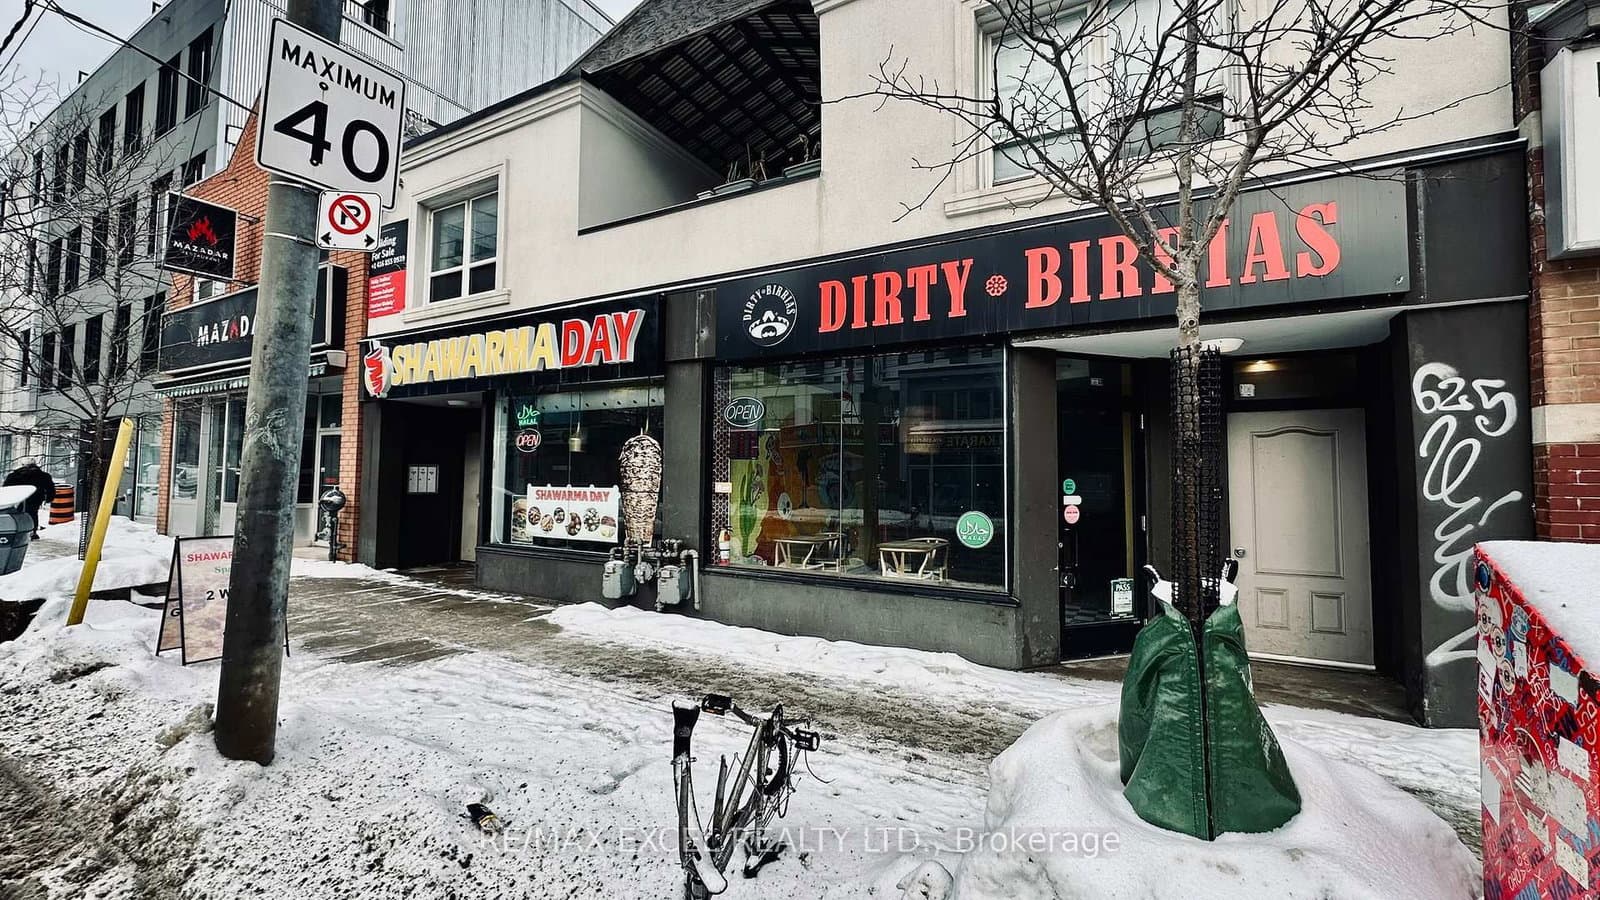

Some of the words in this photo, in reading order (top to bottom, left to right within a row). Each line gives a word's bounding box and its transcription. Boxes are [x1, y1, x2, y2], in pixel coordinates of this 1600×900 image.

[281, 38, 396, 110] MAXIMUM
[274, 100, 390, 183] 40
[173, 240, 229, 260] MAZADAR
[381, 247, 395, 259] Sale
[742, 289, 762, 320] DIRTY
[817, 257, 975, 334] DIRTY
[391, 322, 560, 386] SHAWARMA
[560, 308, 646, 369] DAY
[1412, 361, 1518, 437] 625
[727, 404, 760, 420] OPEN
[518, 433, 539, 447] OPEN
[535, 489, 588, 501] SHAWARMA
[590, 490, 610, 502] DAY
[206, 591, 215, 600] 2
[1115, 583, 1131, 592] PASS
